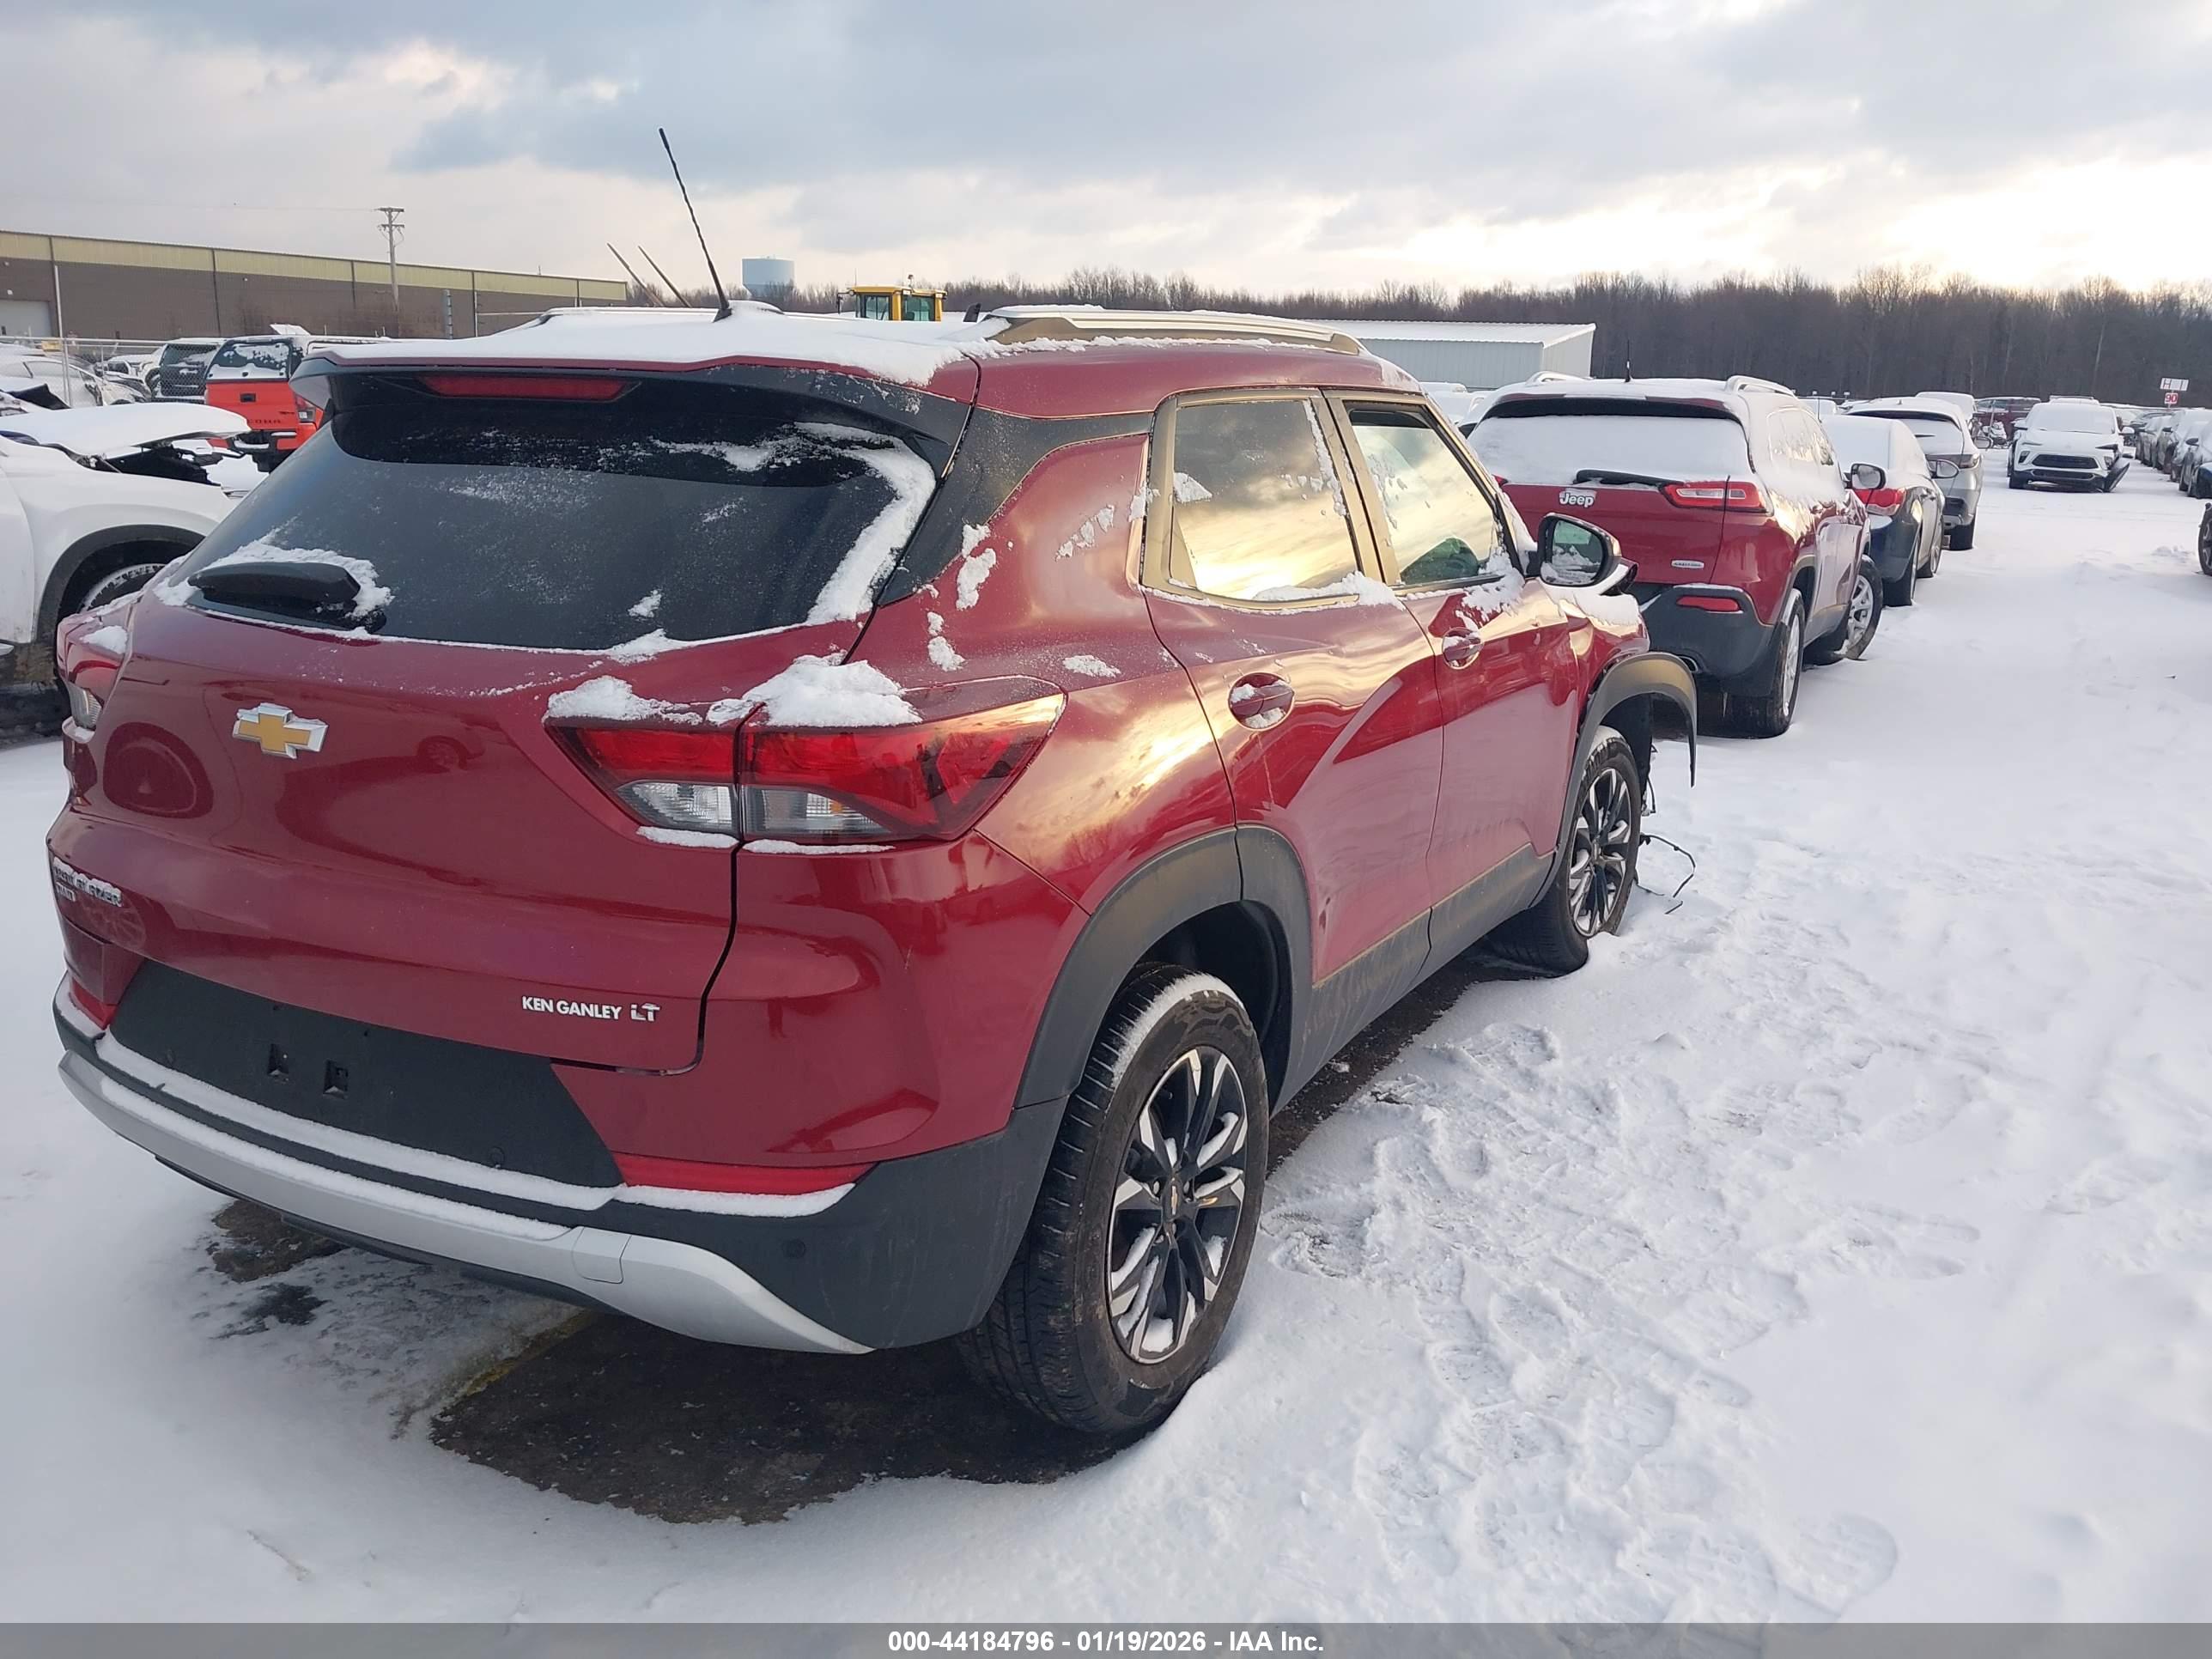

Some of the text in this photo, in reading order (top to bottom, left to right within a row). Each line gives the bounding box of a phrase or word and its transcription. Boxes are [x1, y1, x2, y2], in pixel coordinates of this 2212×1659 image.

[2165, 393, 2178, 403] 90
[1559, 492, 1594, 508] Jeep
[521, 996, 660, 1022] KEN GANLEY LT
